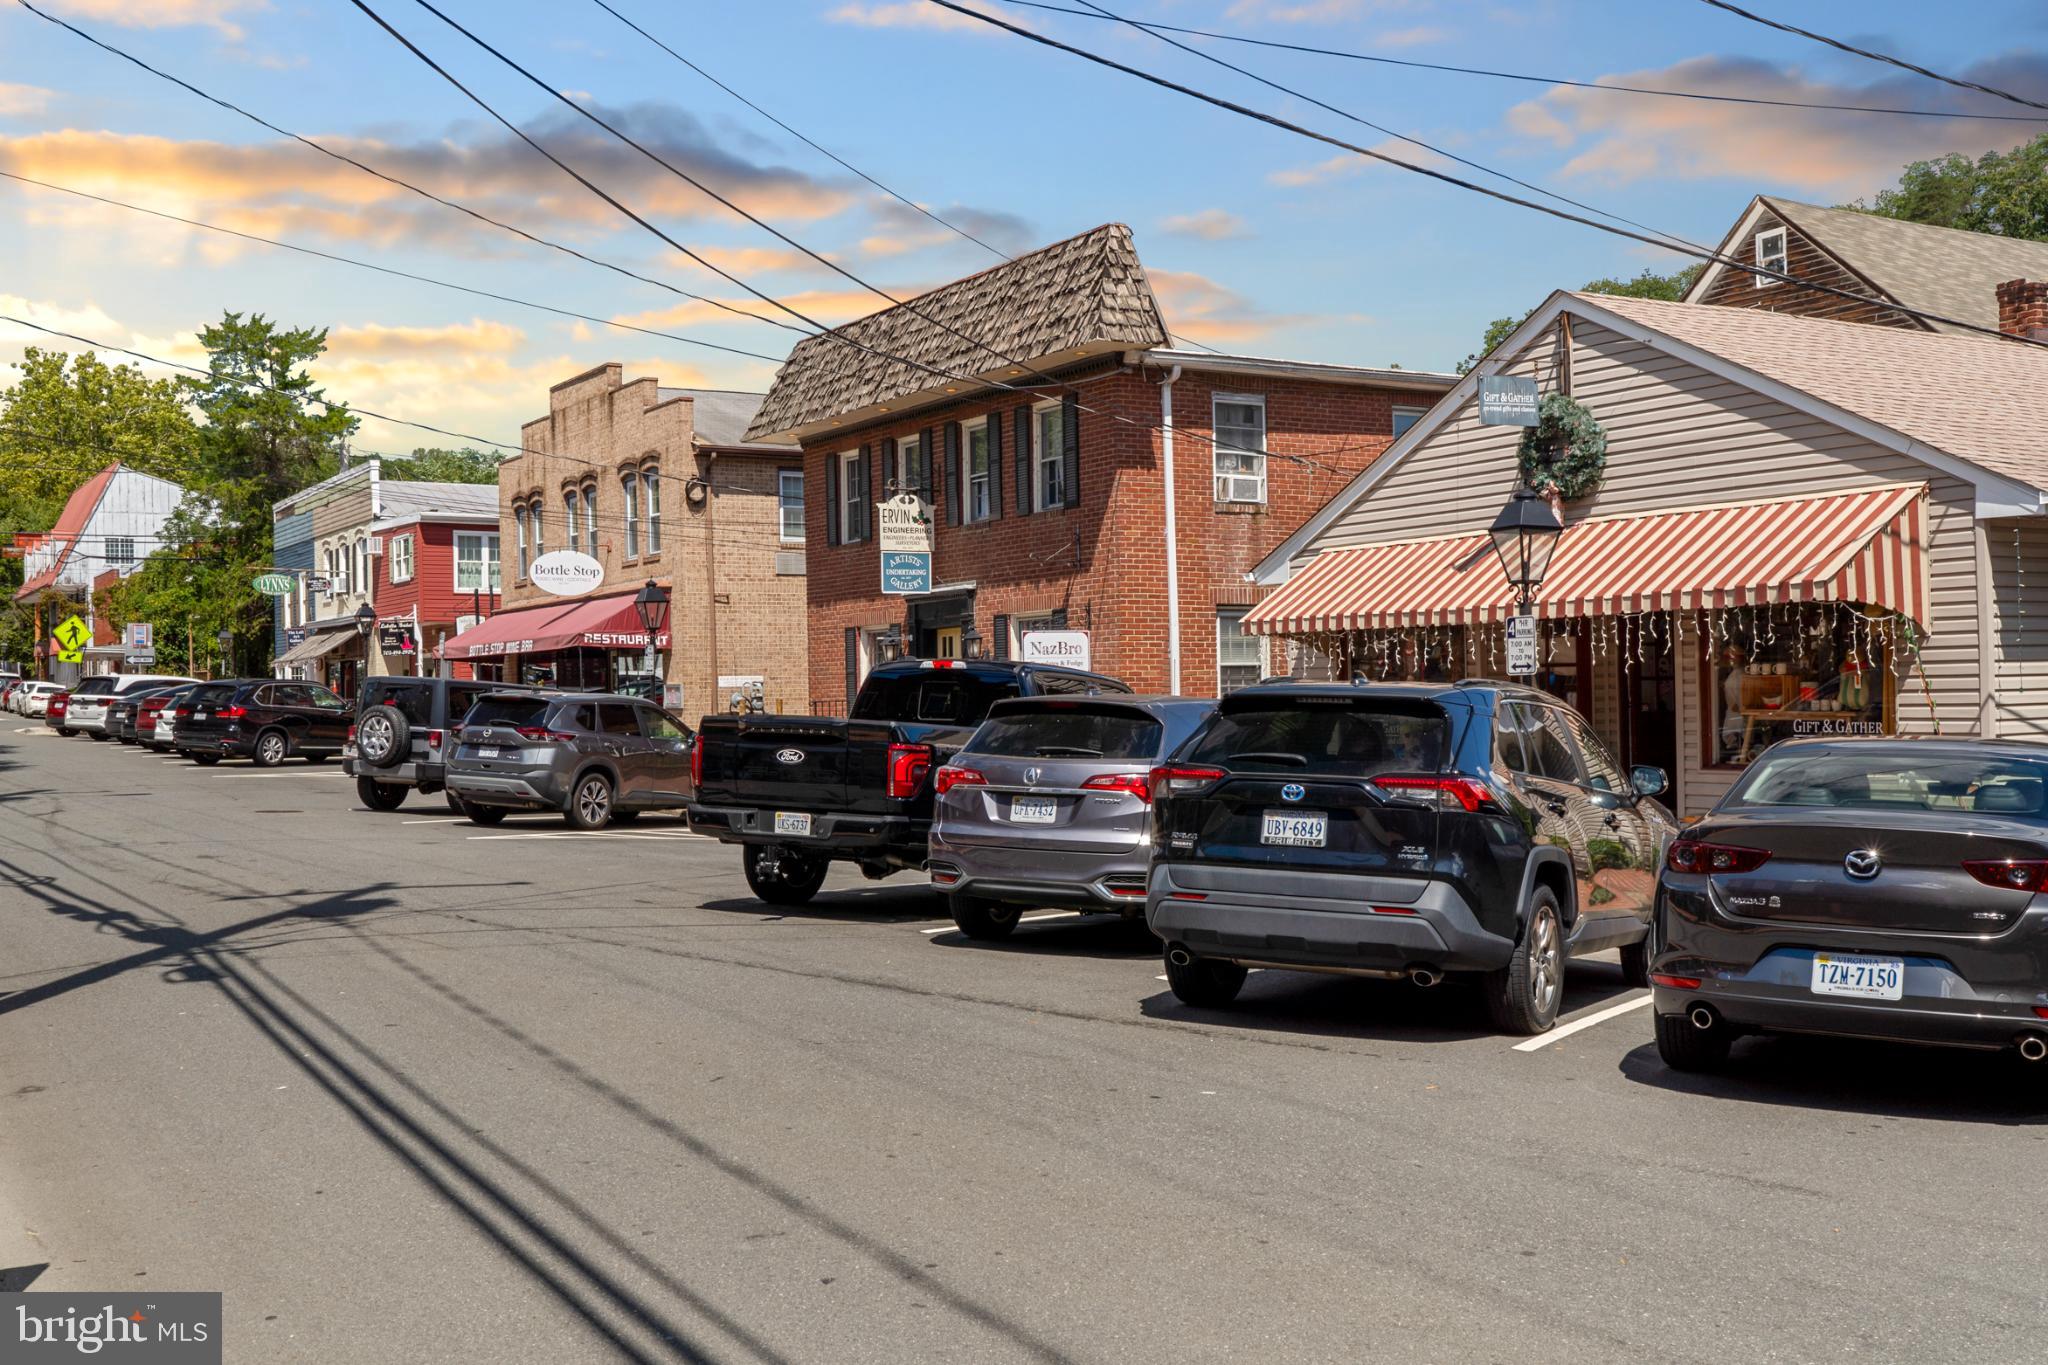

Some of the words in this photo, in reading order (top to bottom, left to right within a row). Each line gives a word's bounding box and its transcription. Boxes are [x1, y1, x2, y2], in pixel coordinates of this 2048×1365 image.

[1484, 391, 1500, 402] GIFT
[1501, 392, 1508, 402] &
[1508, 392, 1534, 403] GATHER
[882, 508, 910, 524] ERVIN
[882, 526, 932, 534] ENGINEERING
[535, 564, 570, 576] Bottle
[573, 564, 600, 579] Stop
[890, 576, 923, 590] GALLERY
[1508, 620, 1515, 636] 4
[469, 644, 489, 657] BOTTLE
[489, 641, 505, 655] STOP
[1030, 641, 1083, 656] NazBro
[1524, 653, 1532, 661] PM
[1793, 719, 1820, 733] GIFT
[1822, 719, 1833, 733] &
[1835, 719, 1884, 734] GATHER
[780, 751, 800, 761] Ford
[1014, 802, 1054, 816] UFK-7432
[1267, 819, 1322, 838] UBV-6849
[1836, 955, 1879, 967] VIRGINIA
[1819, 963, 1898, 989] TZM-7150
